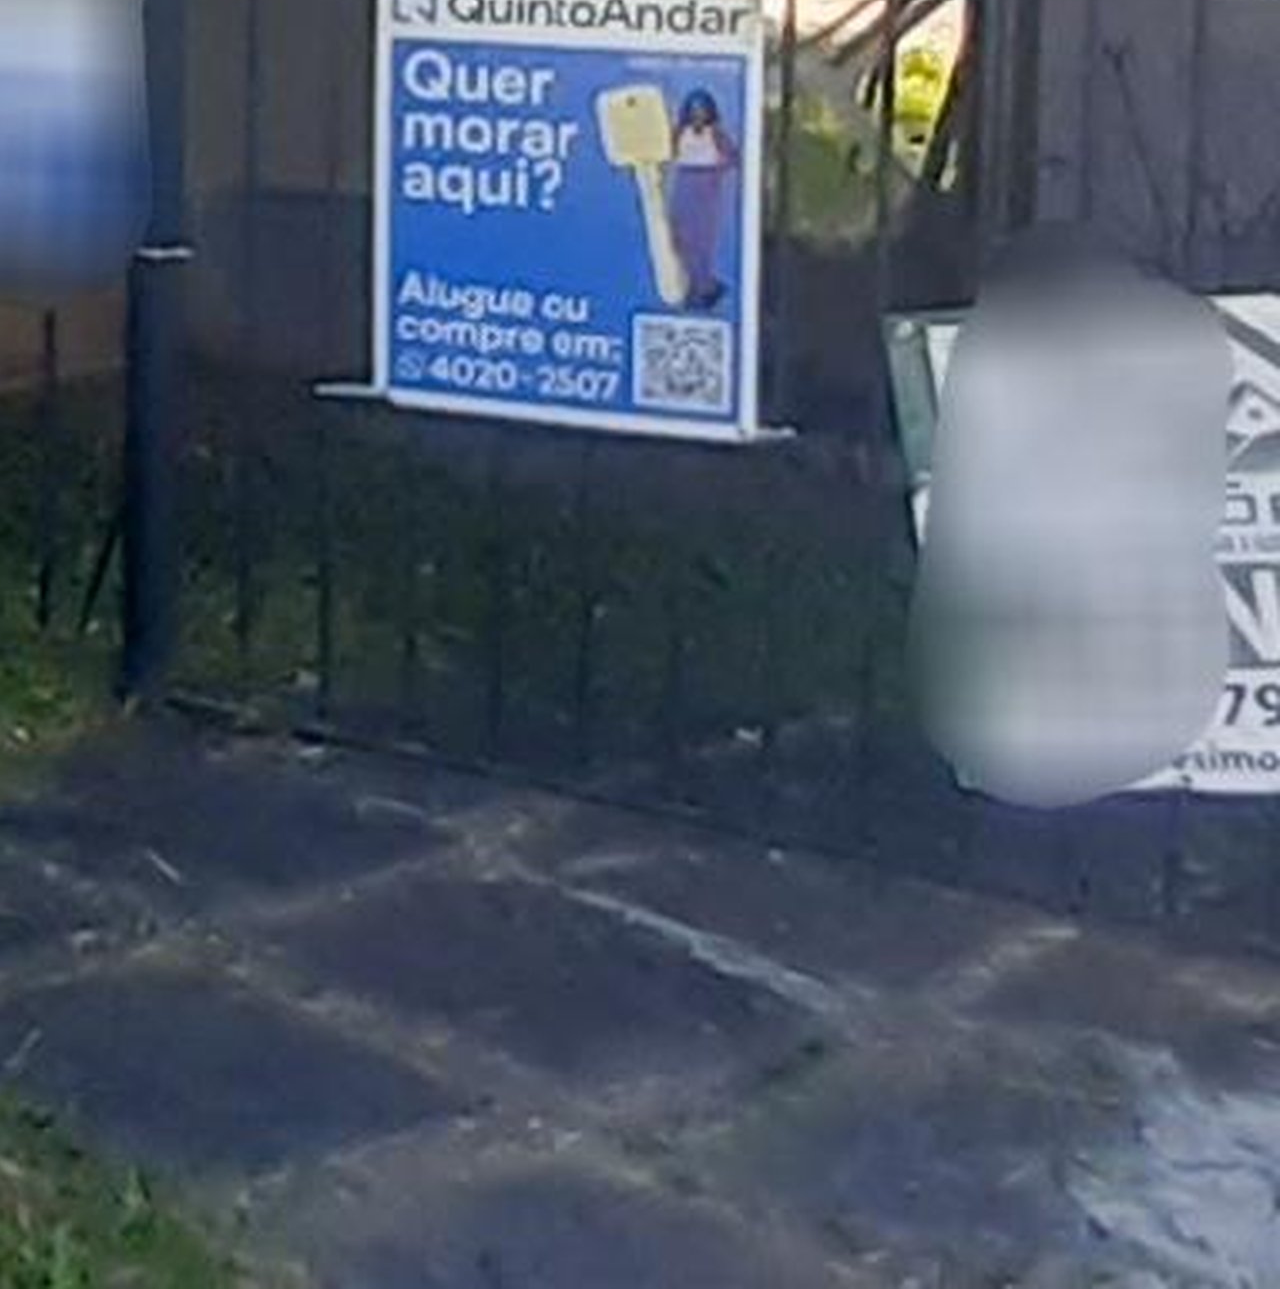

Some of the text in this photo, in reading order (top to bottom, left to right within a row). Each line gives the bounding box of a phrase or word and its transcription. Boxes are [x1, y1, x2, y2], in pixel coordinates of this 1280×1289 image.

[402, 47, 555, 107] Quer
[401, 109, 580, 159] morar
[402, 157, 563, 213] aqui?
[397, 269, 536, 320] Alugue
[395, 314, 545, 355] compre
